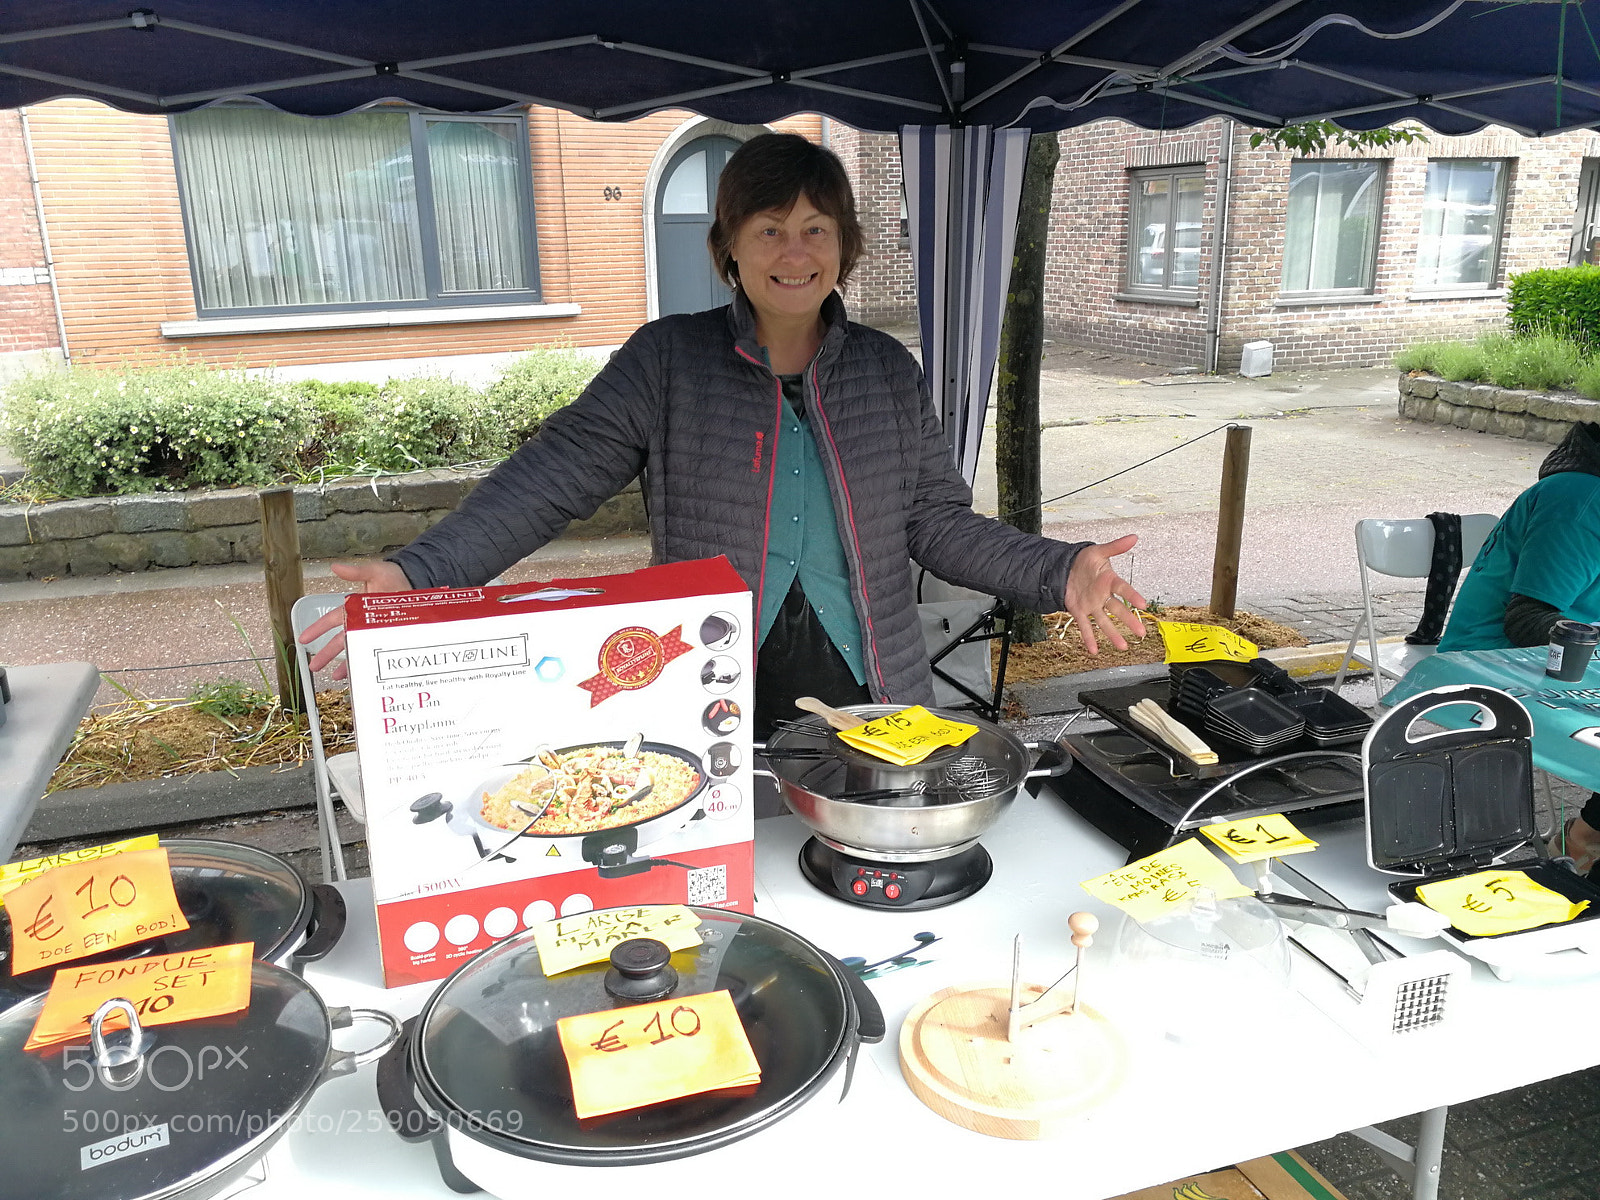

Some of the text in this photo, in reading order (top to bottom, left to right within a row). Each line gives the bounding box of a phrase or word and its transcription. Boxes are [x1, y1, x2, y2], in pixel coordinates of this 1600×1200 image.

[603, 186, 622, 201] 96
[372, 595, 431, 605] ROYALTY
[387, 645, 518, 670] ROYALTY LINE
[381, 691, 440, 714] Party Pan
[1255, 823, 1291, 844] 1
[1139, 859, 1161, 873] DE
[1484, 878, 1516, 902] 5
[24, 874, 137, 941] € 10
[556, 908, 651, 937] LARGE
[39, 914, 177, 960] DOE EEN BOD!
[74, 953, 213, 988] FONDUE
[154, 970, 216, 991] SET
[591, 1005, 701, 1052] € 10
[89, 1129, 162, 1160] bodum
